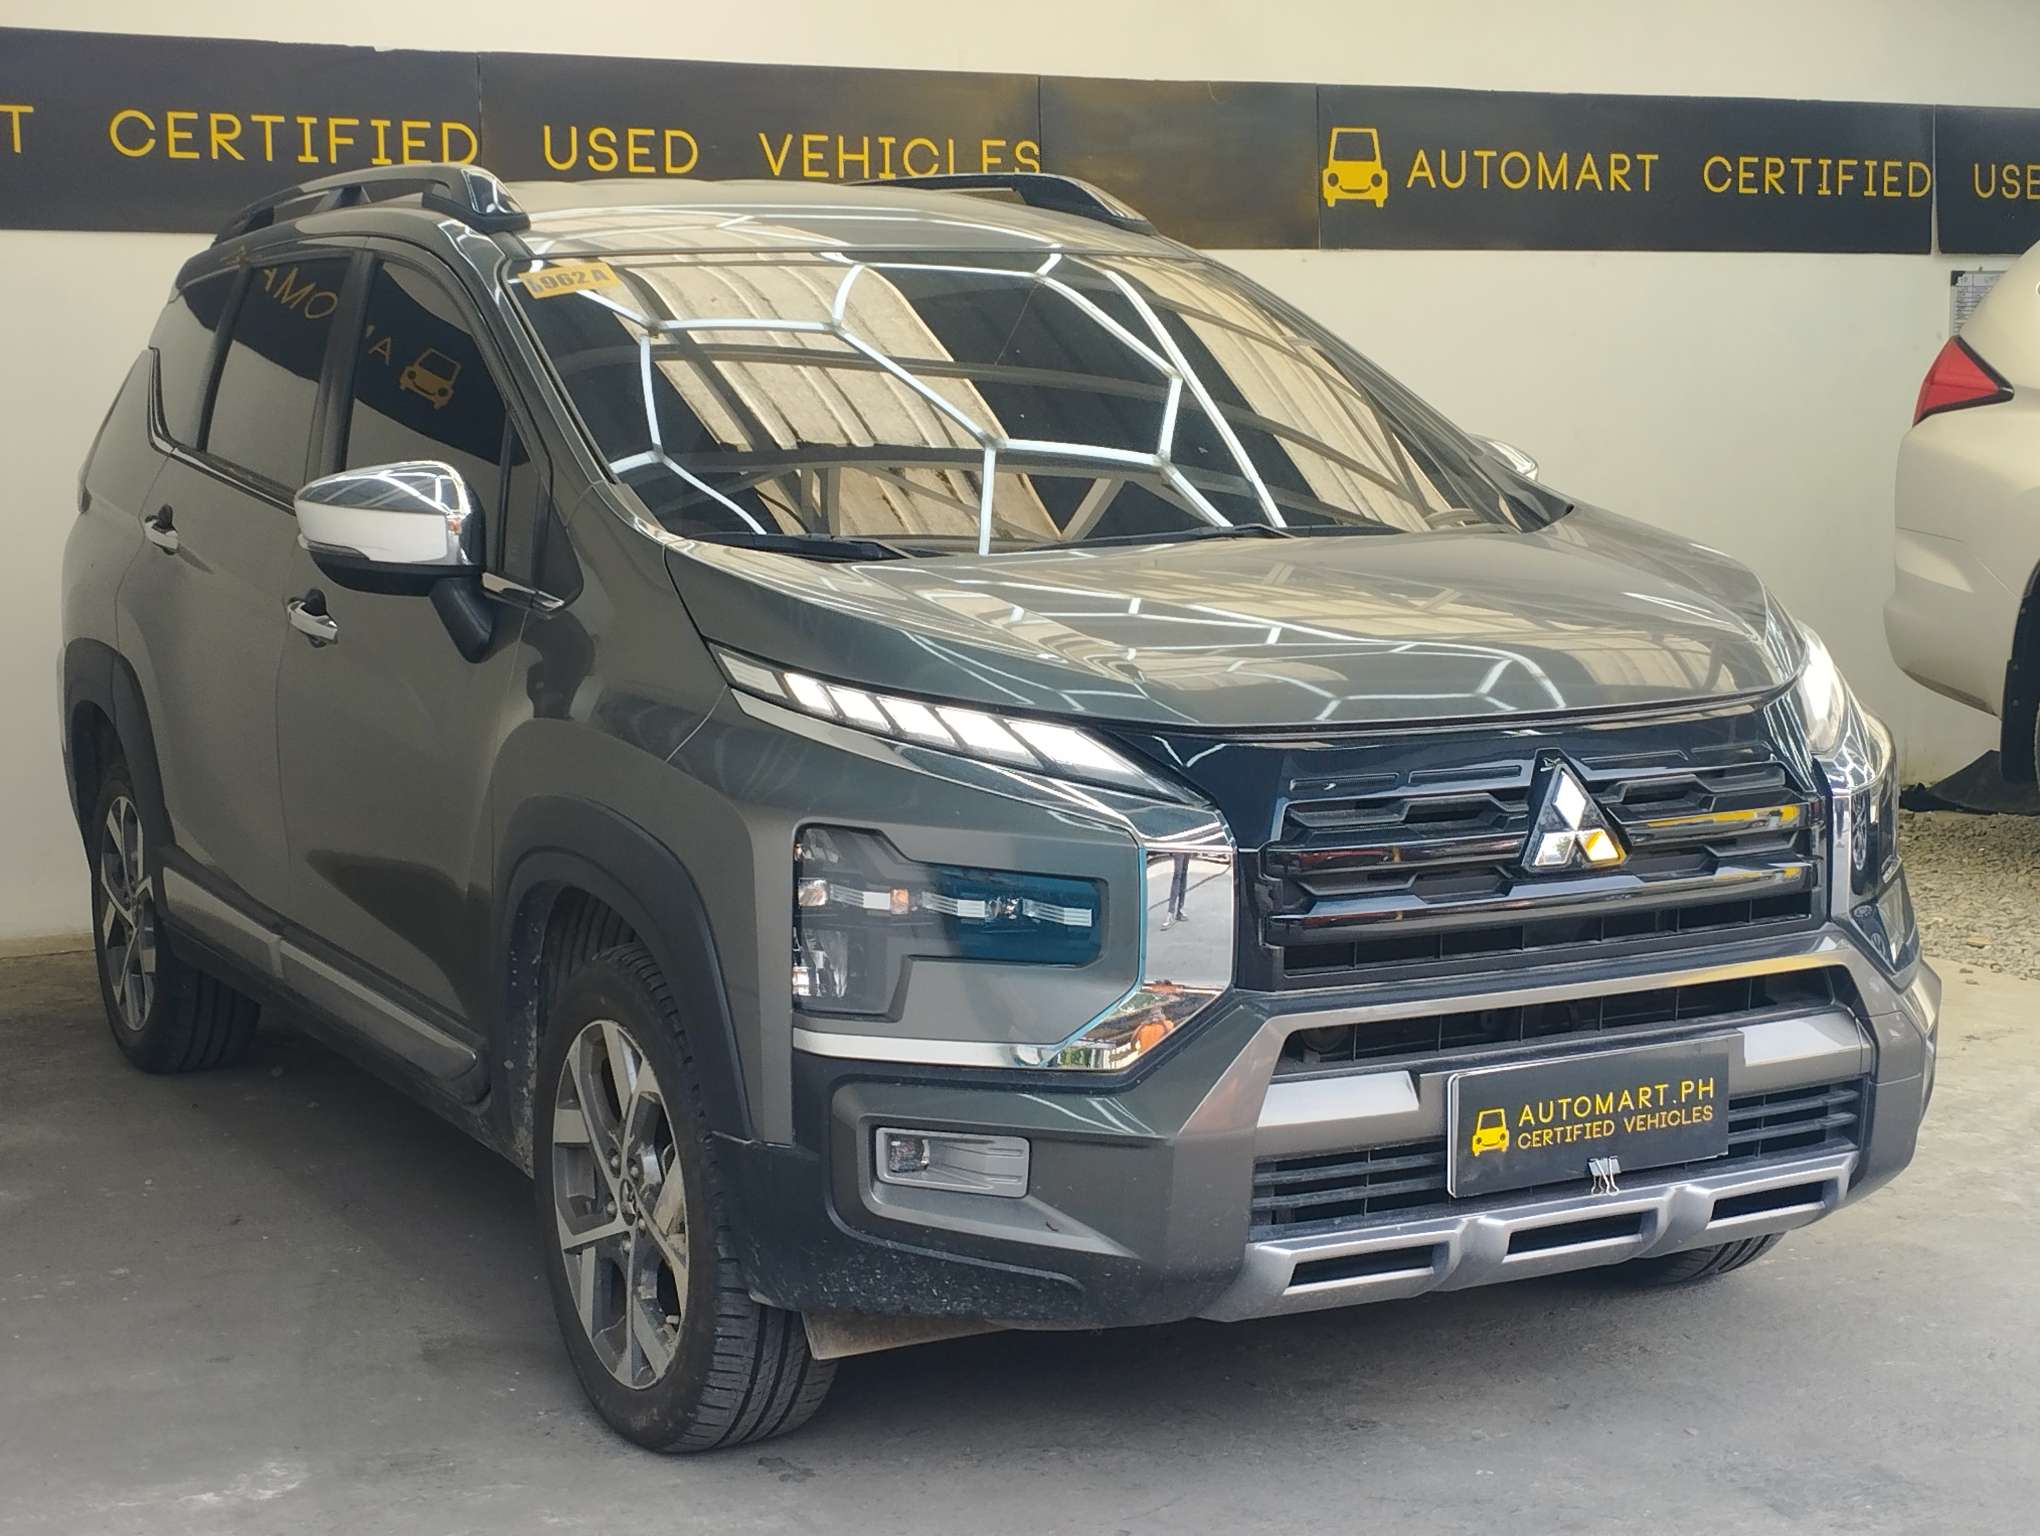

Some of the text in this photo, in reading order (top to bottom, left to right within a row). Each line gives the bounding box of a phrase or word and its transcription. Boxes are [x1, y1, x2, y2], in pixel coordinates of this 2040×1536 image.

[108, 108, 478, 165] CERTIFIED
[542, 123, 699, 176] USED
[1406, 148, 1659, 193] AUTOMART
[1702, 154, 1932, 199] CERTIFIED
[1516, 1104, 1715, 1150] CERTIFIED VEHICLES
[1517, 1076, 1715, 1128] AUTOMART.PH
